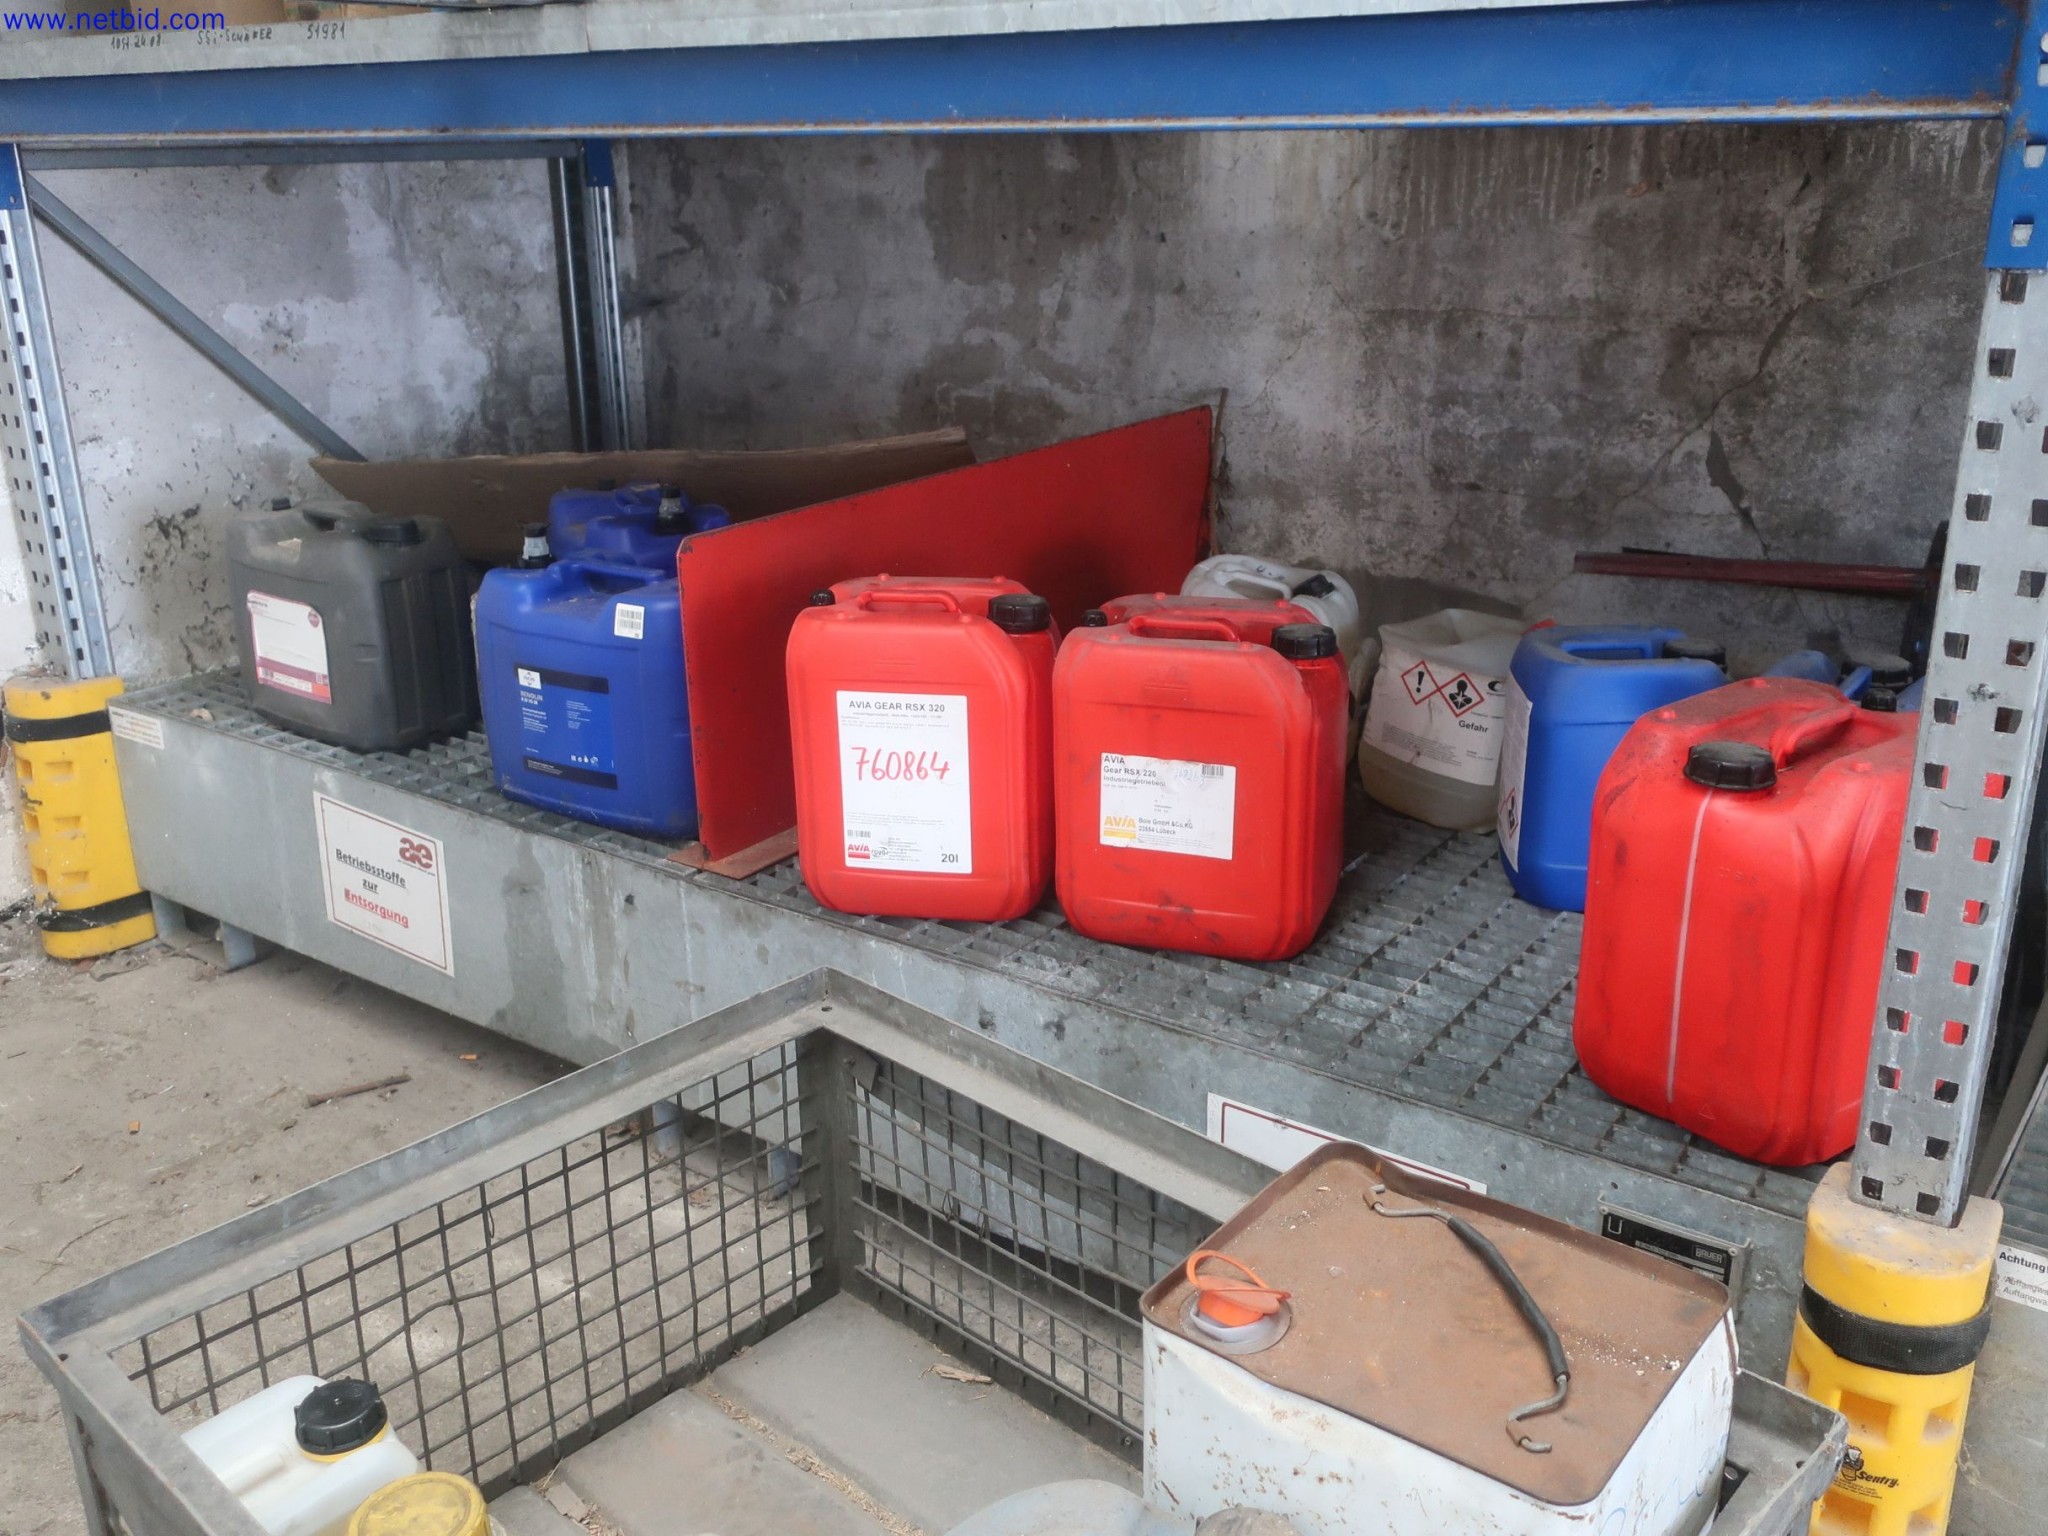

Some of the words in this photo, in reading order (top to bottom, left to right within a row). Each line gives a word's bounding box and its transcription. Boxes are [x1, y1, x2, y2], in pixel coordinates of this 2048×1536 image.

[849, 700, 872, 709] AVIA
[874, 701, 902, 710] GEAR
[905, 703, 926, 712] RSX
[928, 704, 946, 713] 320
[1458, 719, 1489, 734] Gefahr
[851, 746, 950, 781] 760864
[1104, 755, 1126, 765] AVIA
[1103, 765, 1122, 775] Gear
[1124, 767, 1141, 776] RSX
[1143, 769, 1157, 778] 220
[1104, 815, 1136, 828] AVIA
[1152, 818, 1171, 827] GmbH
[1156, 827, 1176, 835] Lübeck
[848, 843, 870, 852] AVIA
[336, 849, 406, 888] Betriebsstoffe
[362, 879, 379, 893] zur
[344, 888, 410, 928] Entsorgung
[1695, 1247, 1723, 1264] BAUER
[2002, 1287, 2048, 1306] Auffangwa
[1857, 1470, 1898, 1488] Sentry
